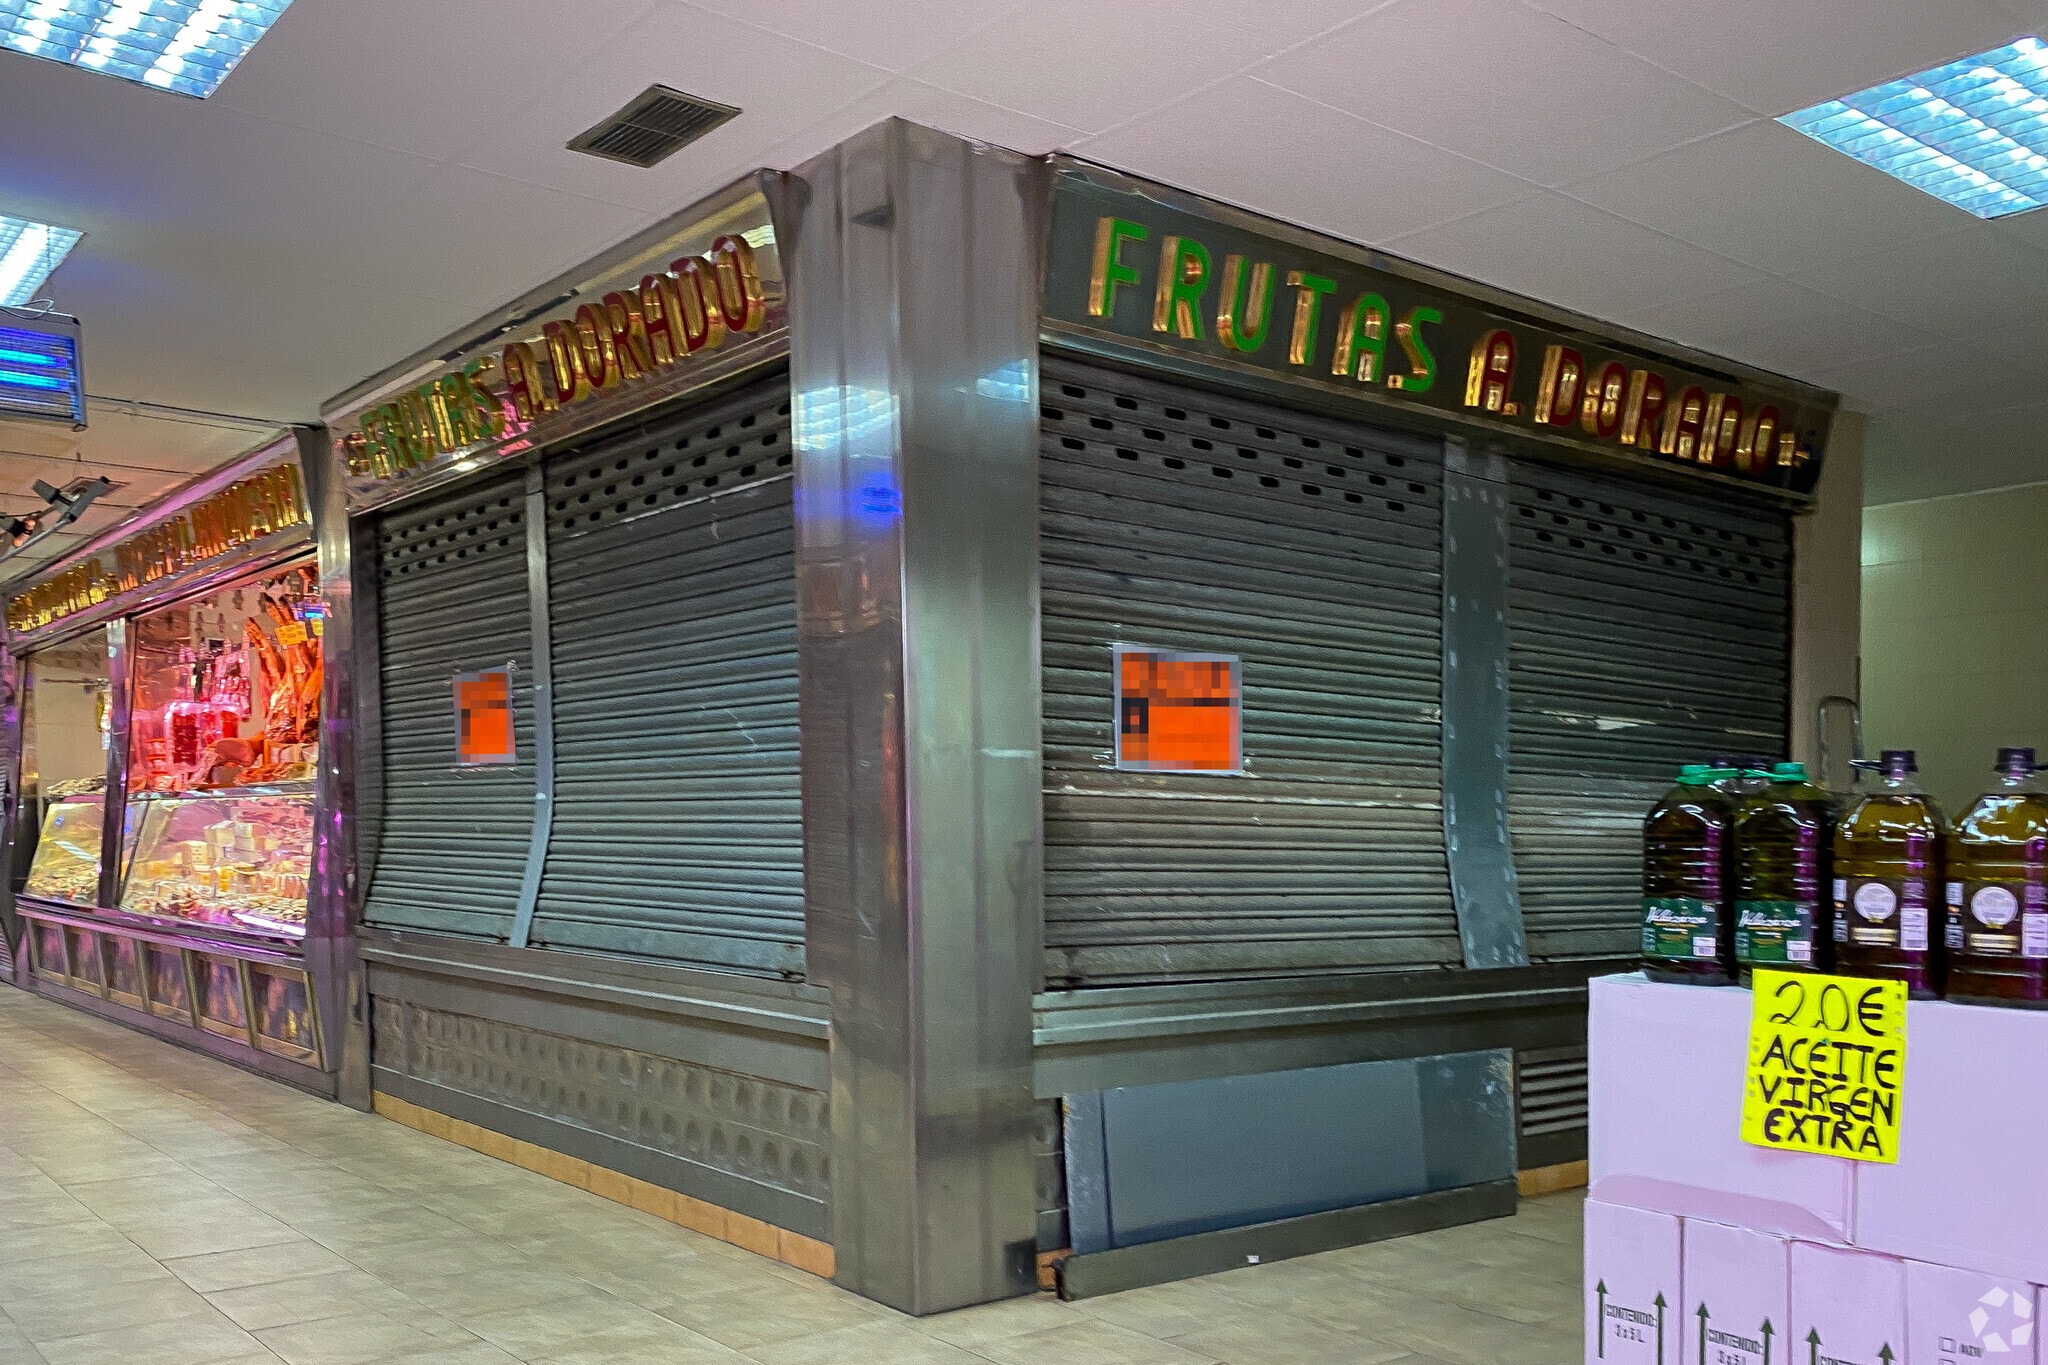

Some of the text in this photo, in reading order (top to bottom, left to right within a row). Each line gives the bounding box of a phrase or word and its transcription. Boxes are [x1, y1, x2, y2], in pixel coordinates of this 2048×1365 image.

[358, 356, 506, 480] FRUTAS
[543, 234, 768, 404] DORADO
[1087, 215, 1444, 393] FRUTAS
[1533, 344, 1779, 475] DORADO
[1760, 1033, 1897, 1090] ACEITE
[1759, 1074, 1894, 1127] VIRGEN
[1764, 1108, 1884, 1157] EXTRA
